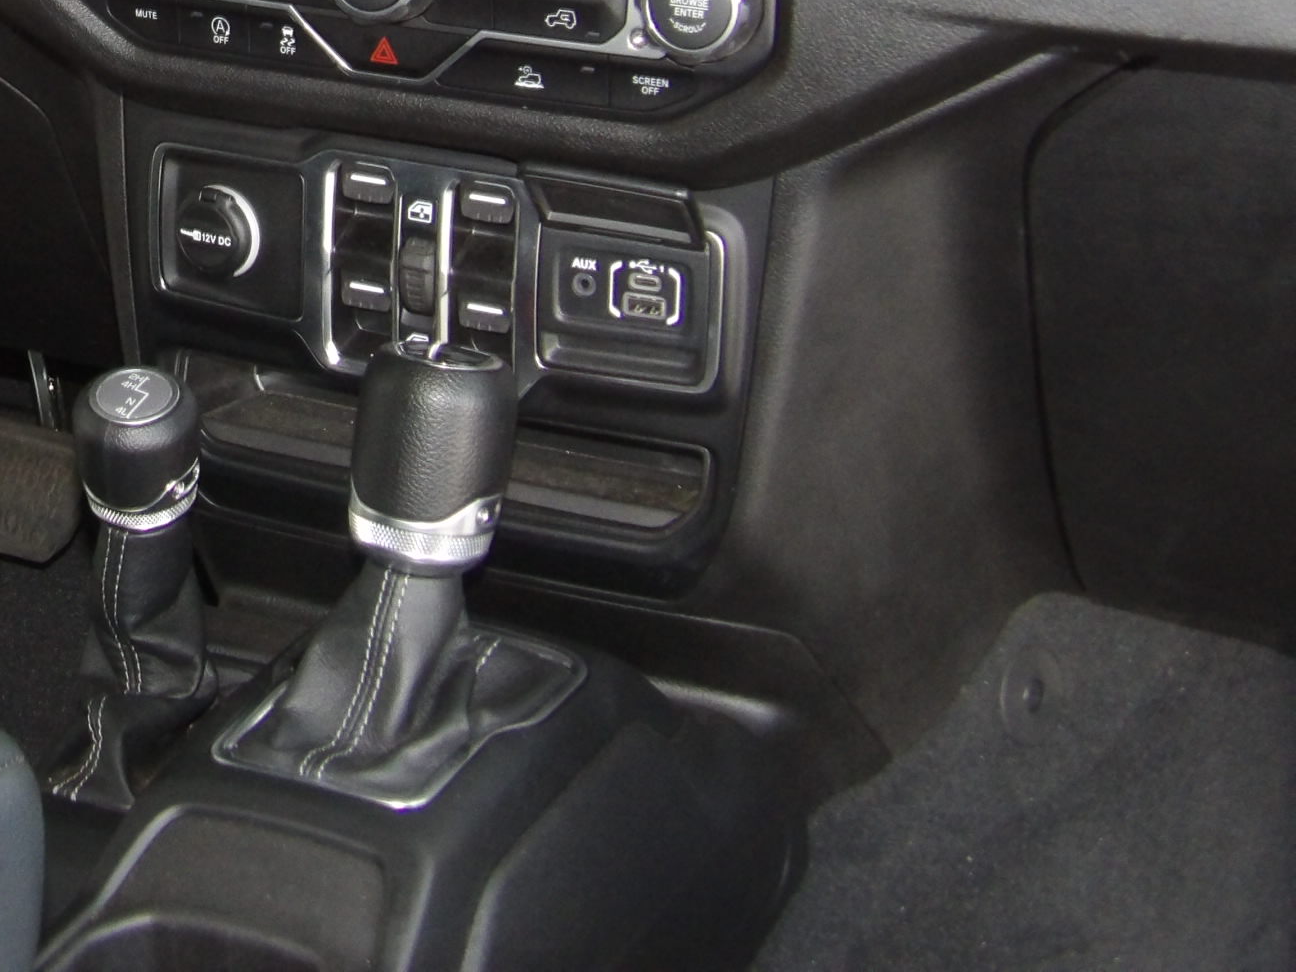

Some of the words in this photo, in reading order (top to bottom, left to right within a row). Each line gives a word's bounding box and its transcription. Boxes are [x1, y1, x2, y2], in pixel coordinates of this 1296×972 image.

[135, 8, 158, 20] MUTE
[674, 7, 705, 19] ENTER
[673, 21, 703, 34] SCROLL
[212, 35, 230, 45] OFF
[279, 46, 296, 56] OFF
[632, 75, 670, 88] SCREEN
[641, 86, 661, 96] OFF
[201, 232, 217, 244] 12V
[218, 236, 232, 247] DC
[571, 257, 597, 271] AUX
[125, 397, 136, 406] N
